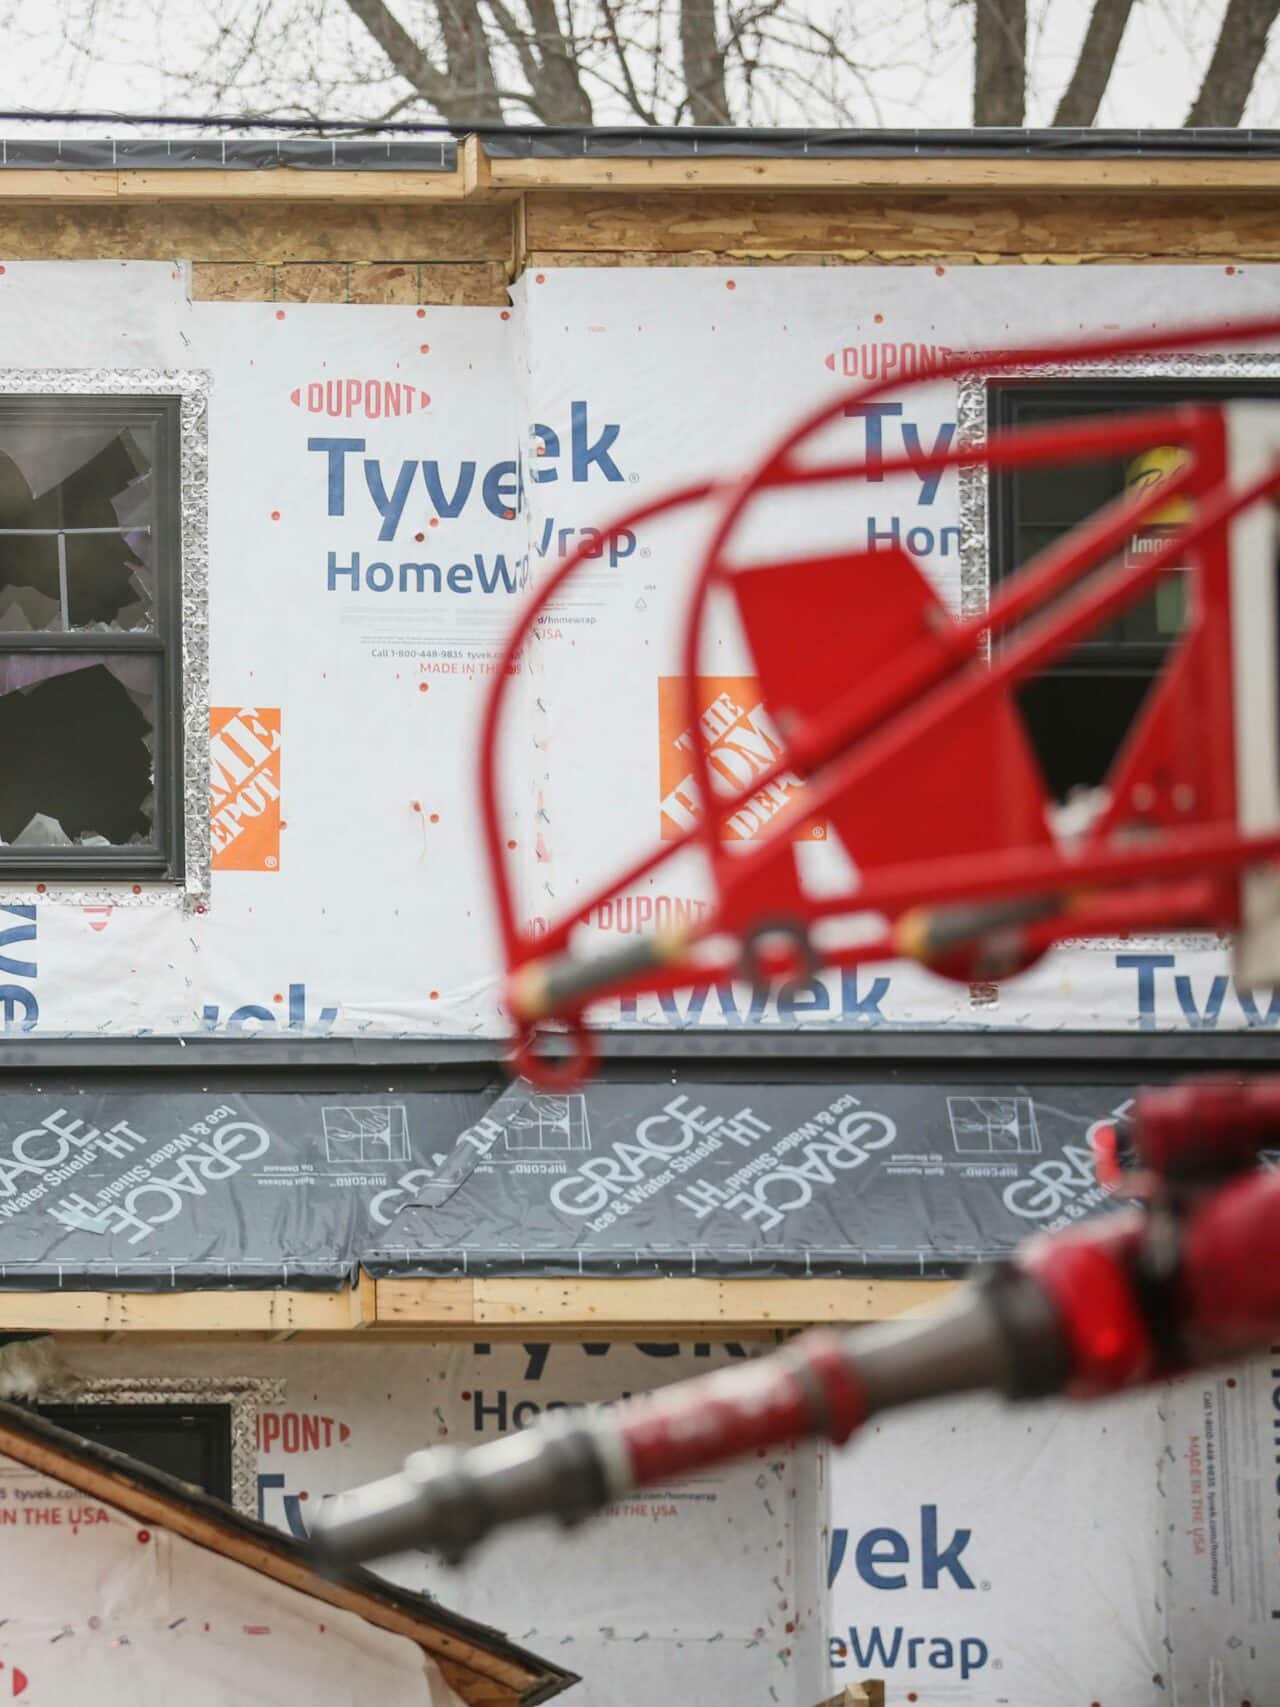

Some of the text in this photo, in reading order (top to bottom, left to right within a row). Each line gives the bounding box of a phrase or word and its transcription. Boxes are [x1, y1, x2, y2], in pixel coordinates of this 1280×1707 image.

[308, 379, 416, 419] DUPONT
[307, 437, 518, 541] Tyve
[327, 552, 518, 594] HomeW
[371, 649, 389, 658] Call
[391, 649, 463, 659] 1-800-448-9835
[419, 663, 458, 674] MADE
[461, 663, 475, 674] IN
[210, 708, 280, 809] ME
[659, 702, 786, 833] HOM
[211, 768, 280, 856] EPOT
[726, 770, 807, 840] DEP
[1116, 955, 1280, 1031] Tyv
[188, 1122, 211, 1136] &
[205, 1104, 237, 1124] Ice
[829, 1094, 862, 1114] Ice
[43, 1149, 99, 1187] Shield
[94, 1120, 148, 1160] HT
[145, 1133, 199, 1169] Water
[549, 1094, 725, 1216] GRACE
[773, 1122, 825, 1157] Water
[1003, 1099, 1136, 1219] GRA
[95, 1122, 270, 1245] GRACE
[585, 1107, 773, 1233] Ice & Water Shield HT
[723, 1110, 897, 1233] GRACE
[675, 1179, 728, 1219] HT
[257, 1412, 336, 1453] PONT
[22, 1508, 62, 1525] THE
[69, 1507, 111, 1525] USA
[829, 1626, 988, 1680] eWrap
